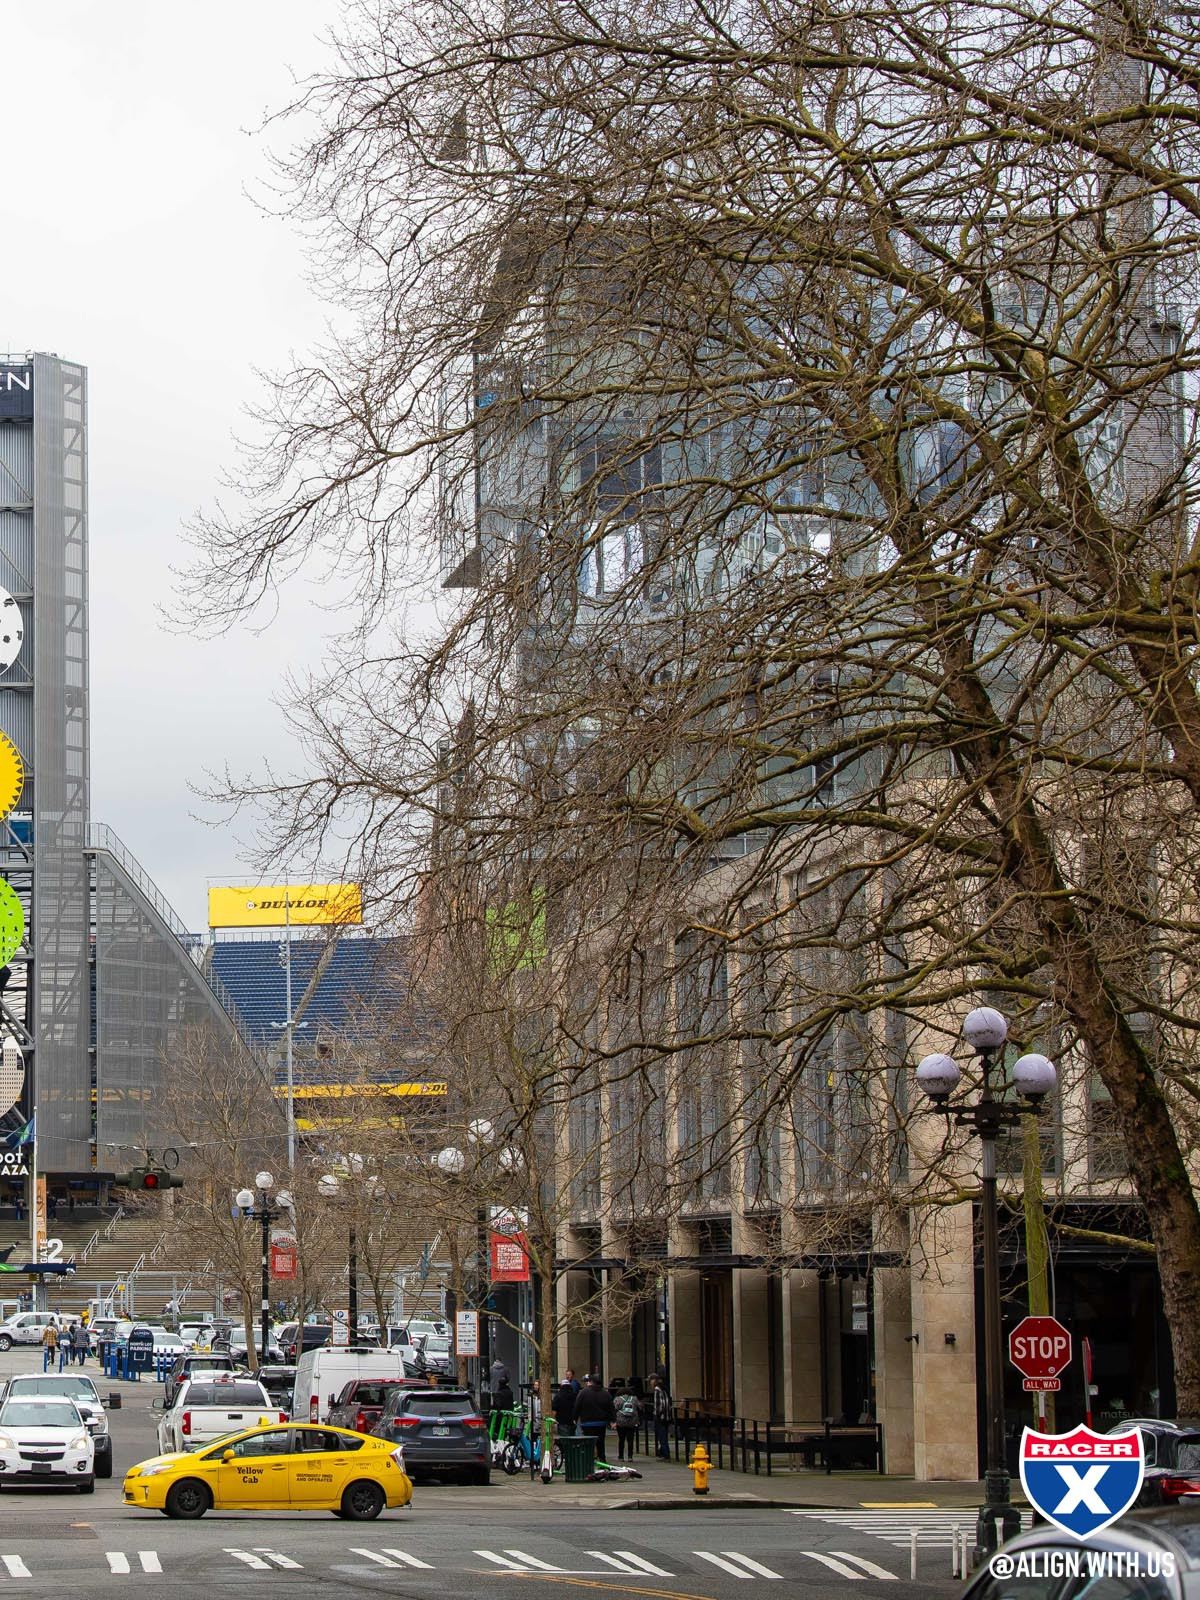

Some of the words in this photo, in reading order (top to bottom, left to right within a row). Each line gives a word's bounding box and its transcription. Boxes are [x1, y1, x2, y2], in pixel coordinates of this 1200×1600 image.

[259, 899, 329, 909] DUNLOP
[40, 1239, 48, 1264] GATE
[47, 1239, 63, 1264] 2
[1014, 1336, 1067, 1359] STOP
[1026, 1381, 1040, 1389] ALL
[1043, 1381, 1057, 1389] WAY
[1101, 1410, 1135, 1419] matsu
[237, 1467, 263, 1475] Yellow
